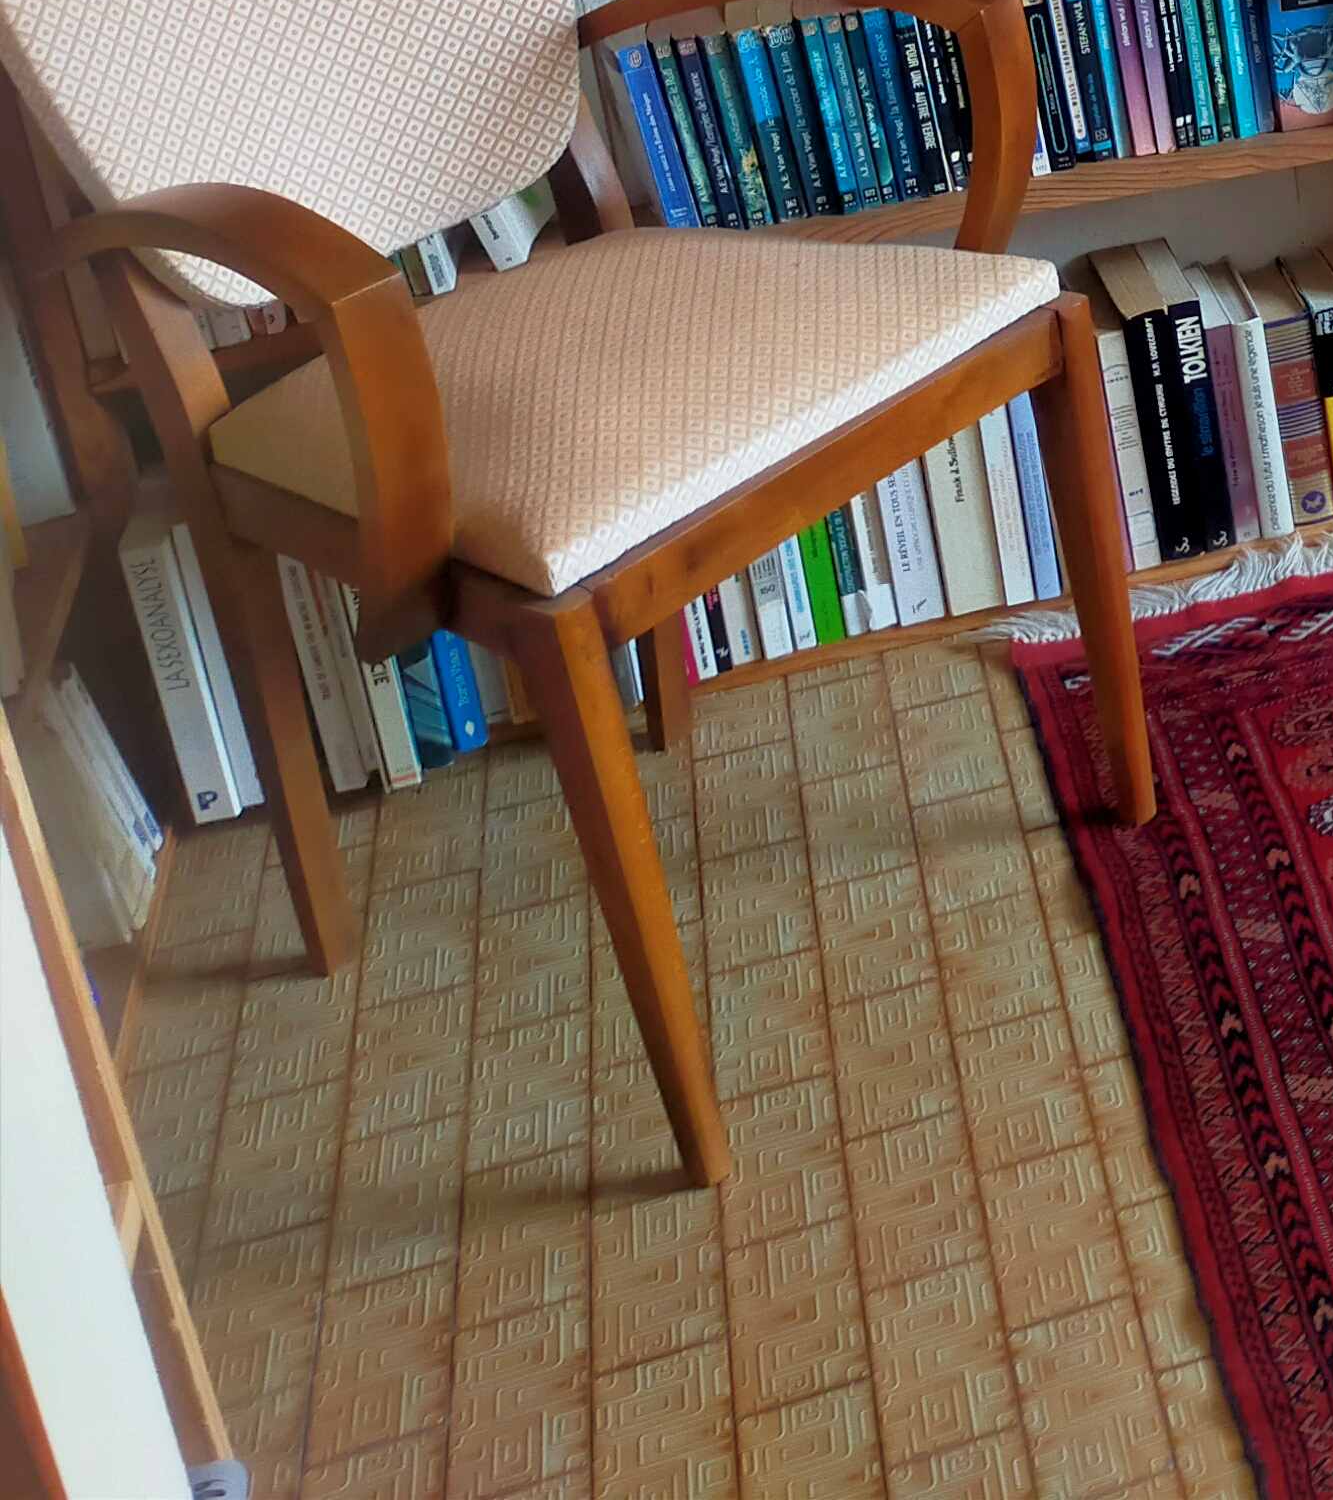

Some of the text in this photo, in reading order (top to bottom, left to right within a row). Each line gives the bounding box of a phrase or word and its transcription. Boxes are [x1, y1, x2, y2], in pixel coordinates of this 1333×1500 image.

[1073, 2, 1086, 21] WUL
[1175, 316, 1208, 383] TOLKIEN
[887, 489, 903, 511] TOUS
[893, 530, 909, 559] RÉVEIL
